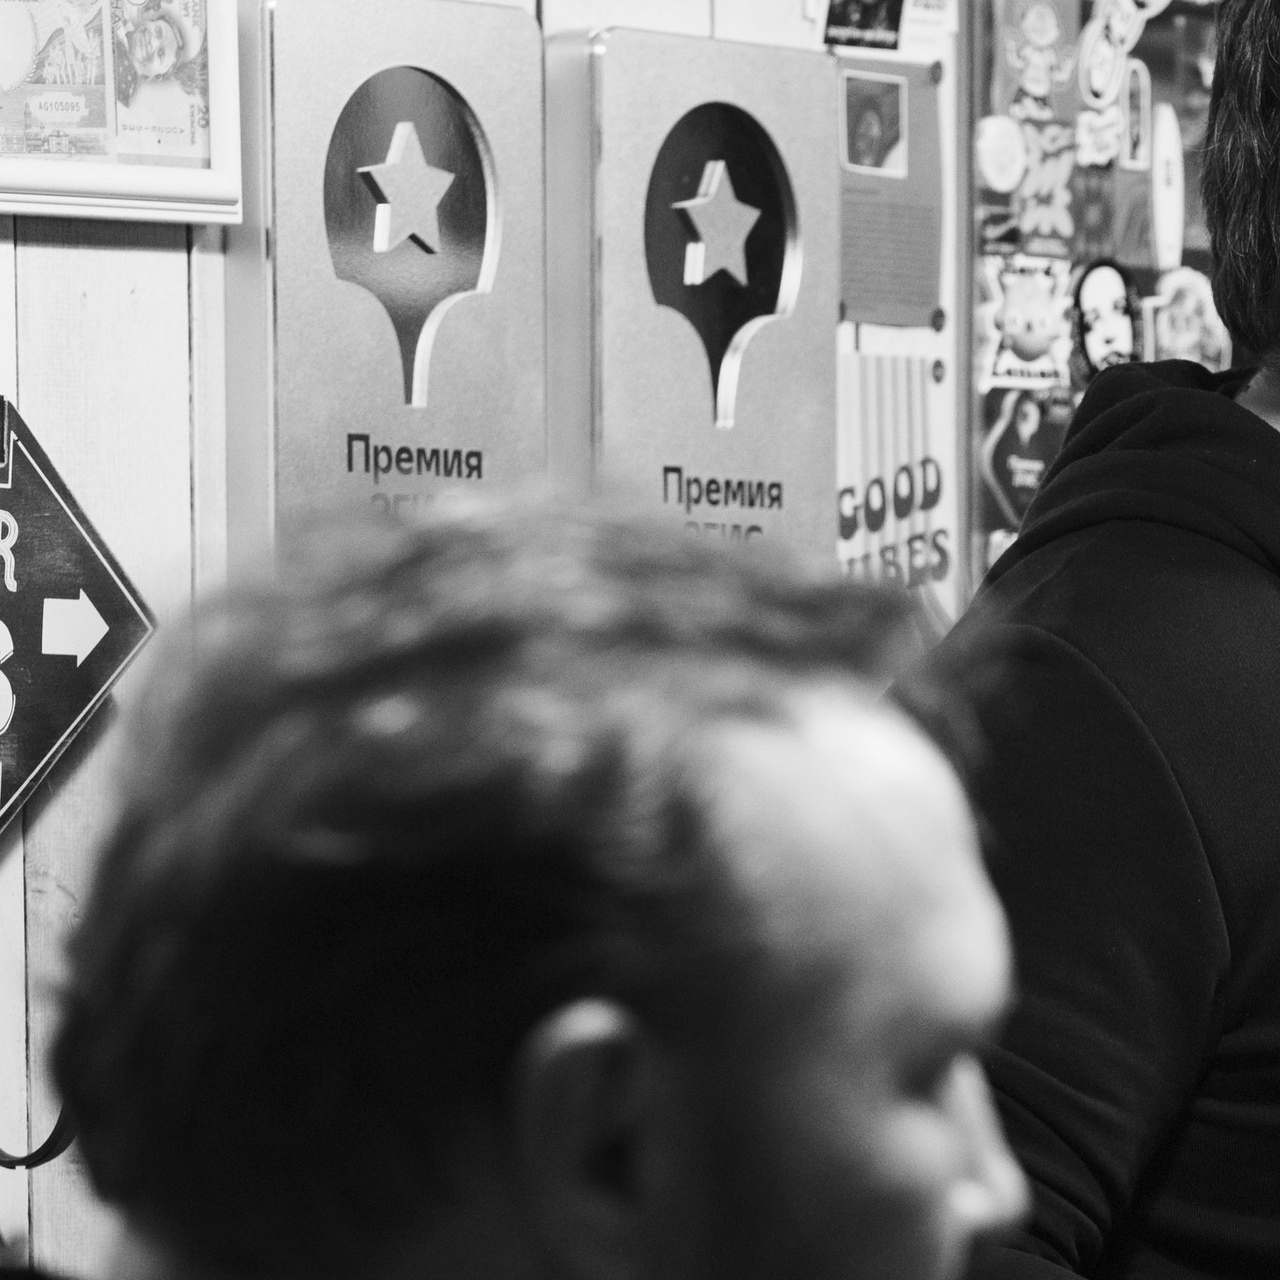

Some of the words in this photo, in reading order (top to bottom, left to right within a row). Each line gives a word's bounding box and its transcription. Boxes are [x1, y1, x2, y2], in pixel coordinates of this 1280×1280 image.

[347, 433, 483, 484] Премия
[663, 466, 783, 514] Премия
[838, 456, 942, 541] GOOD
[840, 528, 949, 589] BES
